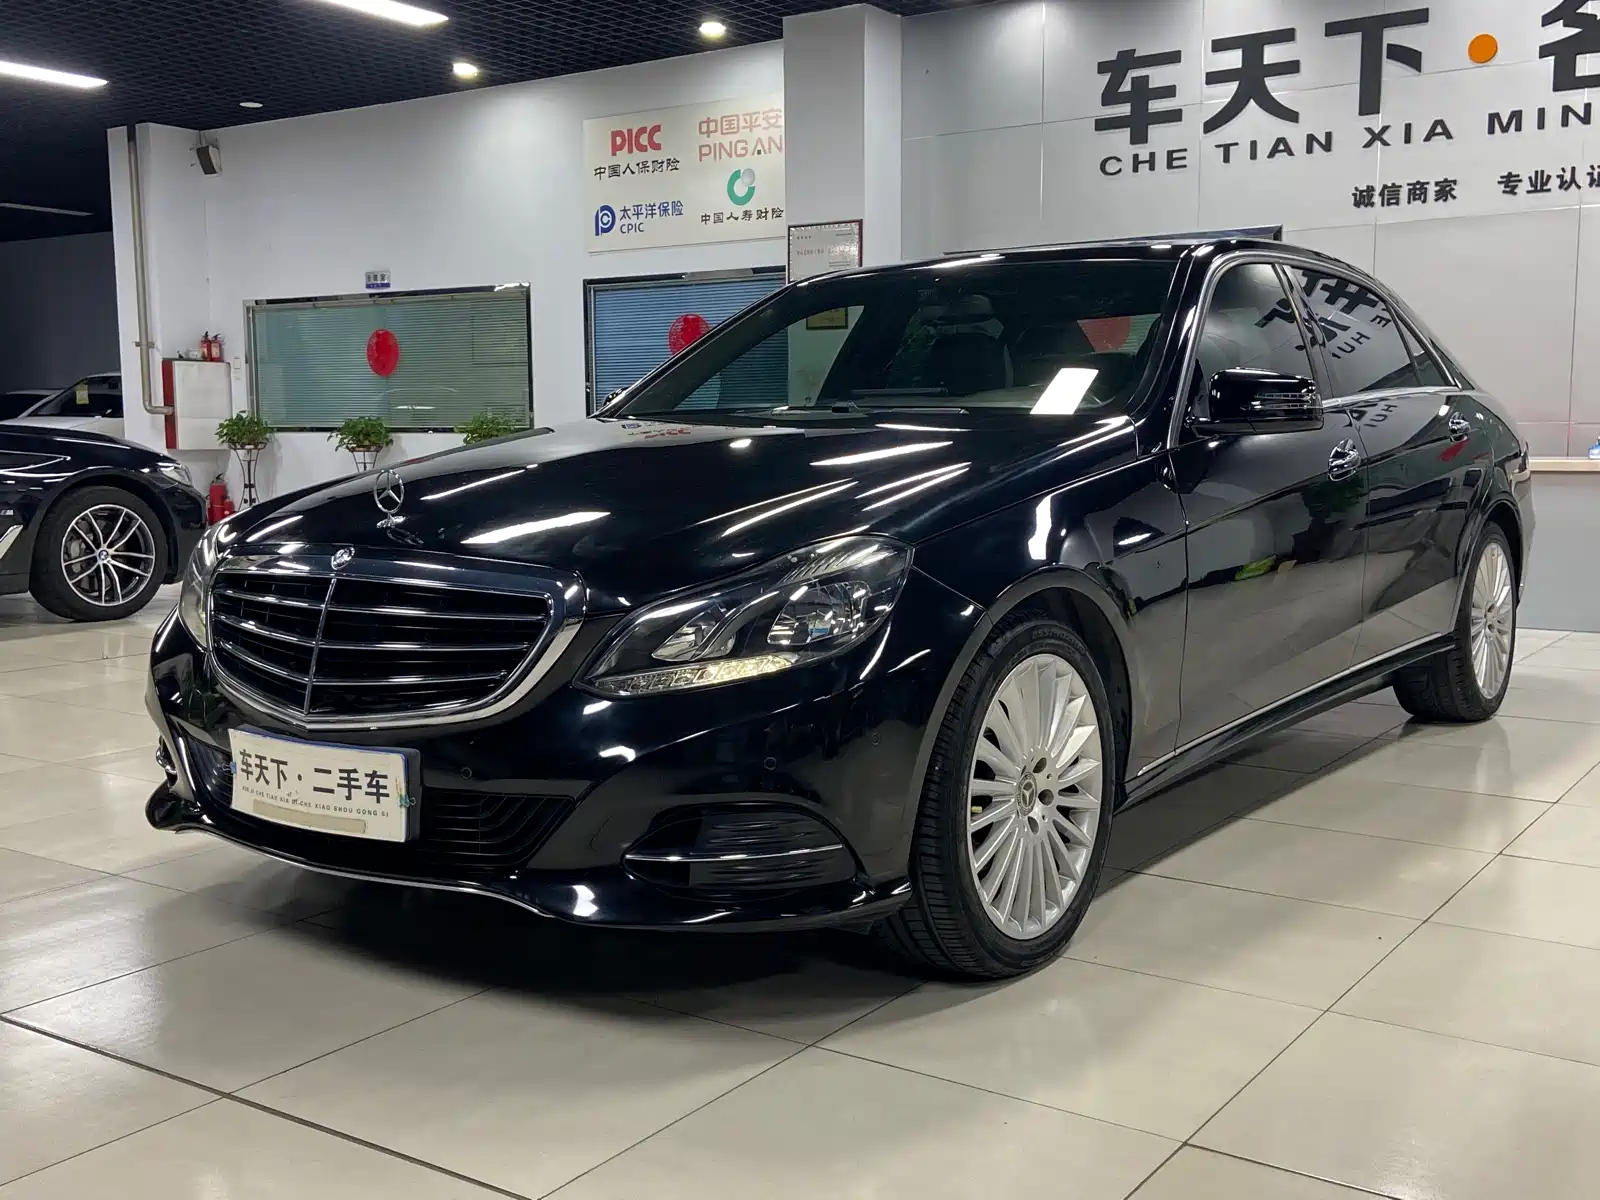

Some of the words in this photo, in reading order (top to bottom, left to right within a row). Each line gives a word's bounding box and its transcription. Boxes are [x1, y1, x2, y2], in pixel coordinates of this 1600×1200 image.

[698, 108, 783, 139] 中国平安
[610, 124, 661, 157] PICC
[1100, 148, 1188, 176] CHE
[1214, 131, 1333, 164] TIAN
[1362, 119, 1454, 149] XIA
[1487, 102, 1592, 135] MIN
[593, 157, 681, 181] 中国人保财险
[1351, 178, 1458, 209] 诚信商家
[619, 200, 684, 221] 太平洋保险
[700, 206, 785, 226] 中国人寿财险
[619, 222, 645, 235] CPIC
[314, 803, 331, 811] XIAO
[333, 805, 354, 814] SHOU
[356, 808, 378, 817] GONG
[381, 810, 390, 818] SI
